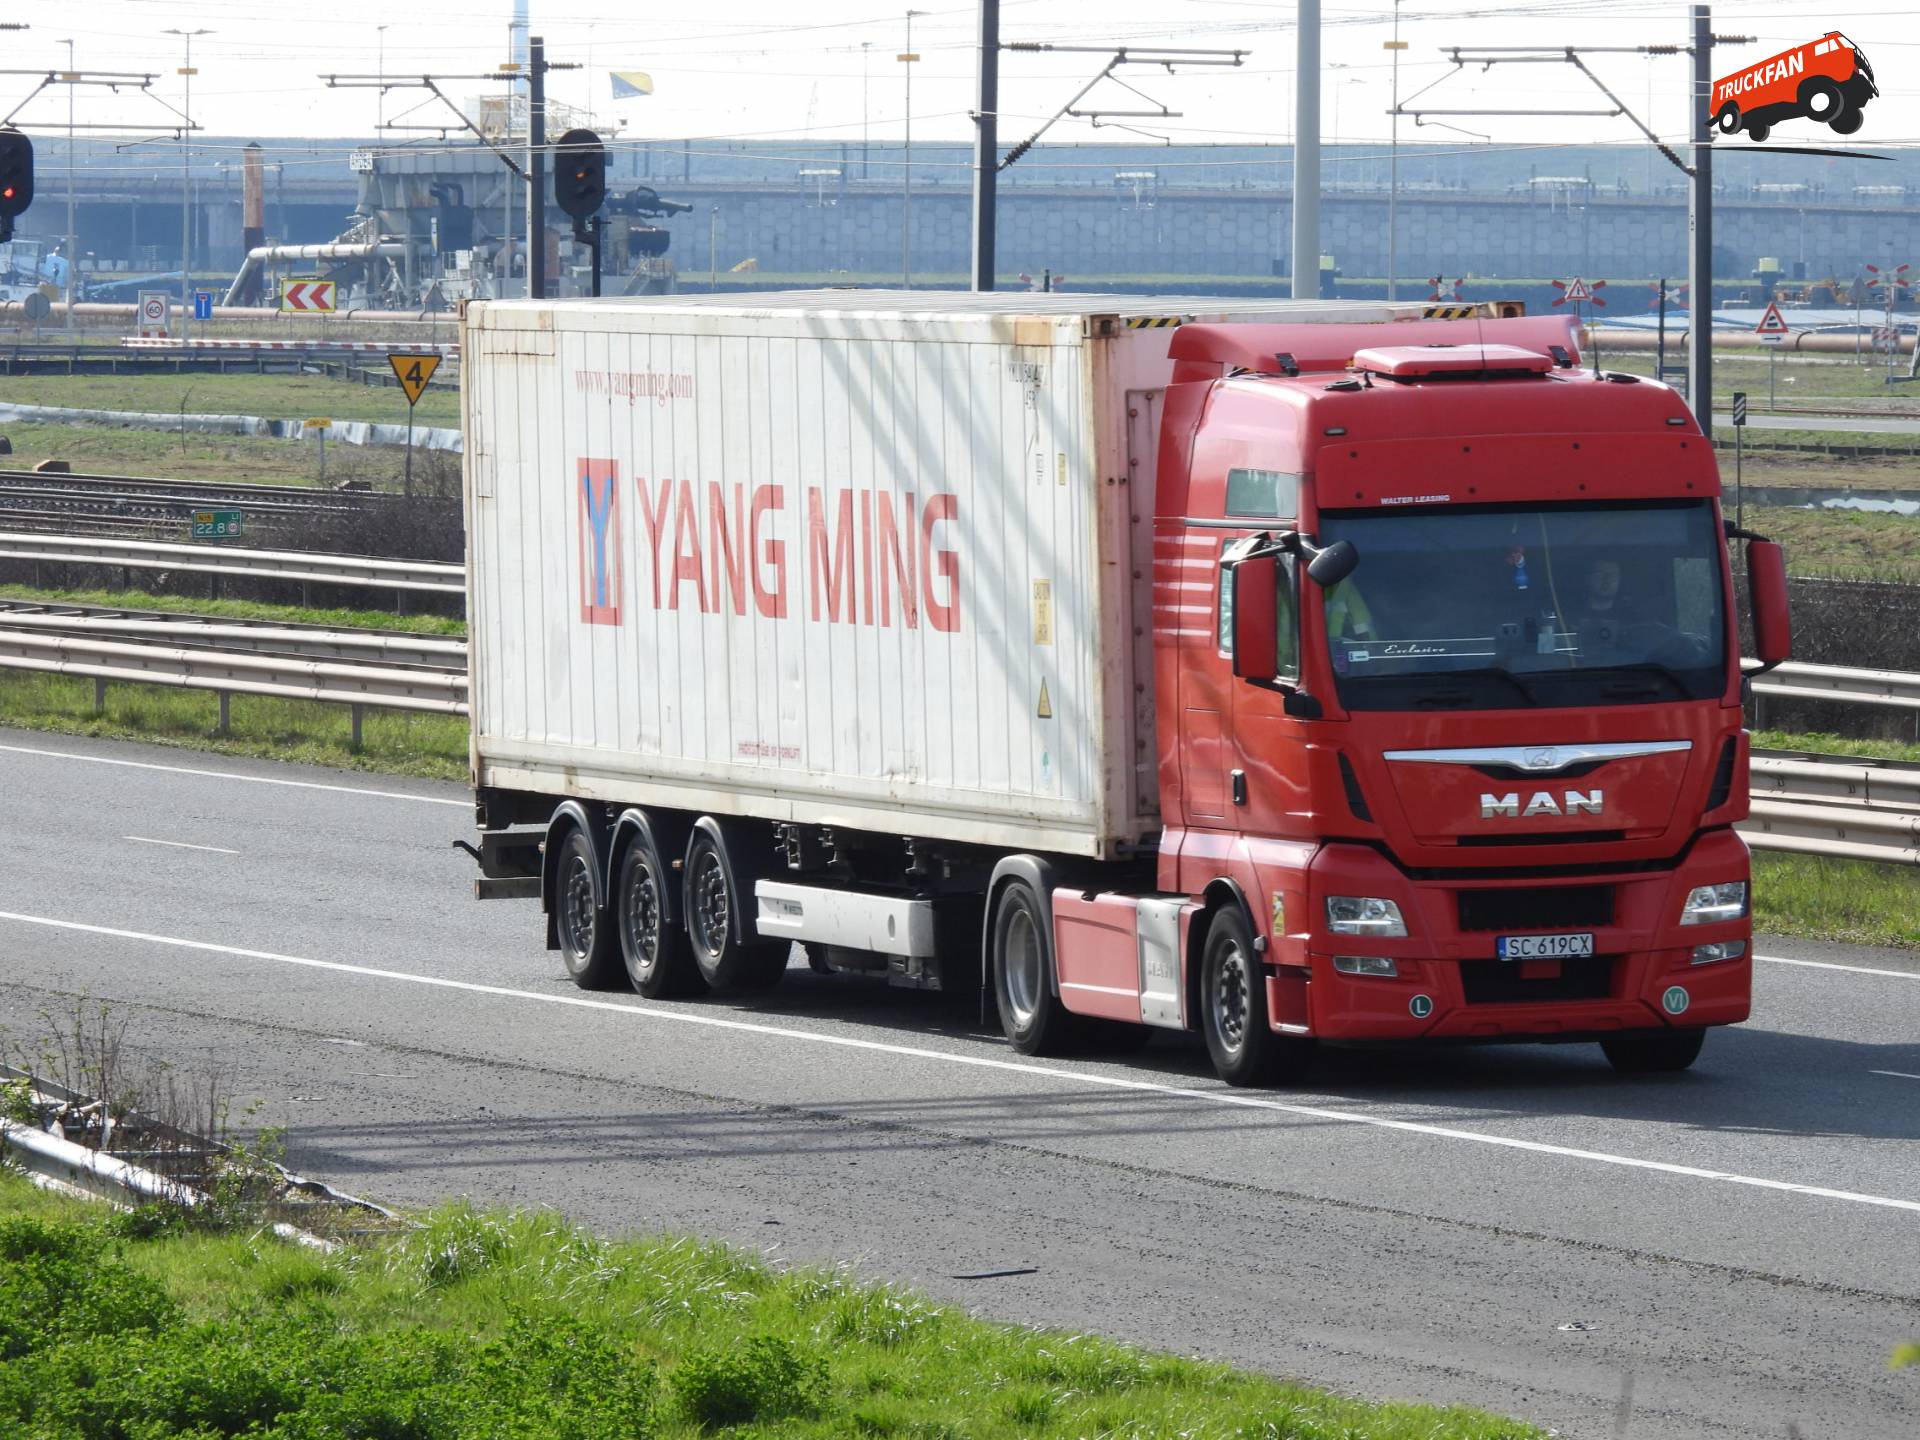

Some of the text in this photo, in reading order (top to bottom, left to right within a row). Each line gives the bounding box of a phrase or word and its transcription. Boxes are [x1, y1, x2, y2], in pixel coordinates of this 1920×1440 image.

[405, 360, 424, 390] 4
[1380, 494, 1451, 505] WALTER LEASING
[196, 523, 225, 534] 22.8
[636, 477, 788, 620] YANG
[808, 486, 961, 633] MING
[1384, 644, 1447, 655] Exclusive
[1480, 789, 1604, 819] MAN
[1509, 939, 1532, 956] SC
[1537, 935, 1590, 955] 619CX
[1416, 999, 1425, 1014] L
[1668, 993, 1683, 1009] VI
